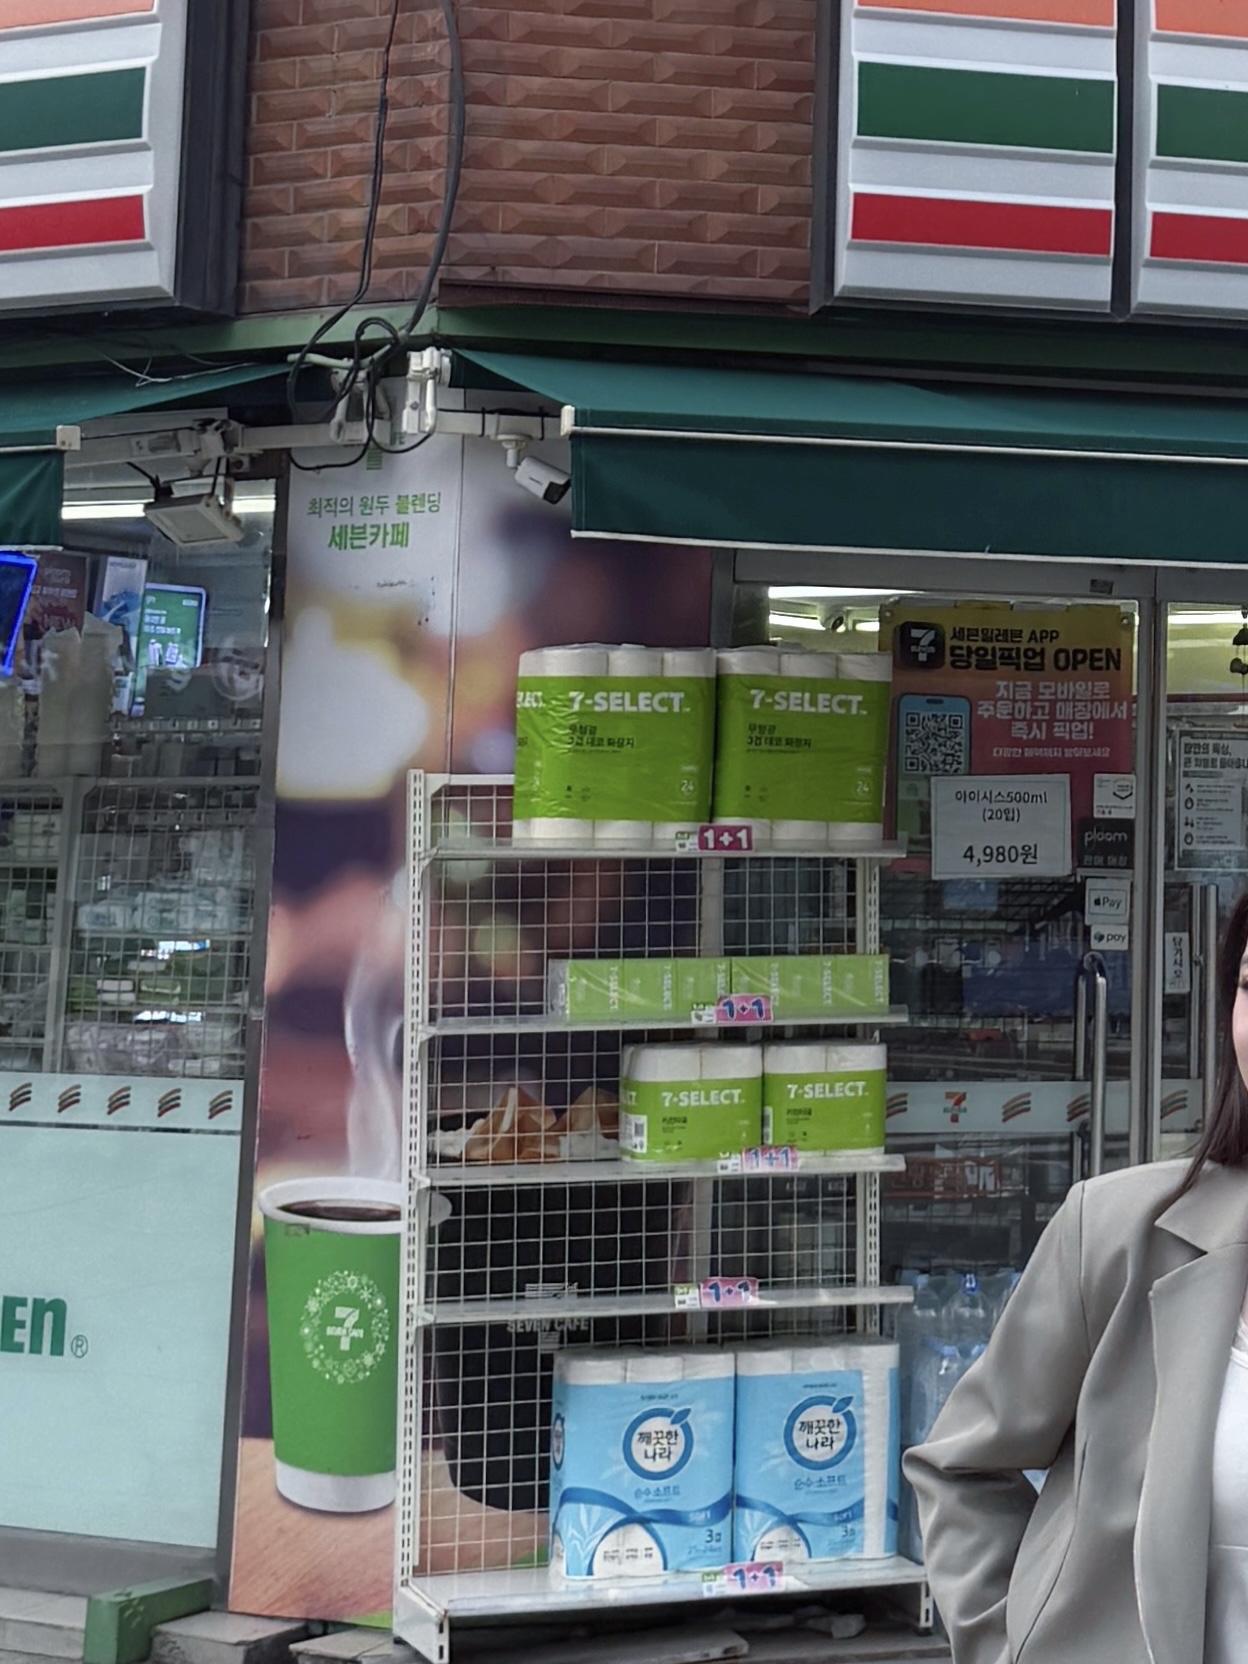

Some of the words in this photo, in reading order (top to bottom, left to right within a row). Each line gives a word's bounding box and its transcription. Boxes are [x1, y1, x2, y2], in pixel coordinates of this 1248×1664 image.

[308, 496, 353, 518] 최적의
[359, 495, 389, 515] 원두
[395, 492, 441, 514] 블렌딩
[328, 522, 410, 550] 세븐카페
[951, 626, 1023, 644] 세븐일레븐
[1027, 629, 1059, 643] APP
[950, 648, 1048, 671] 당일픽업
[1054, 648, 1121, 672] OPEN
[996, 681, 1032, 700] 지금
[1038, 681, 1110, 700] 모바일로
[569, 691, 685, 713] 7-SELECT
[751, 690, 862, 714] 7-SELECT
[977, 701, 1049, 719] 주문하고
[1056, 701, 1127, 719] 매장에서
[1011, 722, 1047, 740] 즉시
[1053, 722, 1094, 740] 픽업!
[955, 790, 1048, 804] 아이시스500ml
[982, 808, 1021, 823] (20입)
[703, 829, 750, 850] 1+1
[1084, 828, 1127, 844] ploom
[963, 844, 1038, 866] 4,980원
[1101, 895, 1122, 910] Pay
[1106, 932, 1127, 945] pay
[722, 998, 765, 1020] 1+1
[662, 1089, 742, 1107] 7-SELECT
[787, 1081, 866, 1098] 7-SELECT
[749, 1147, 790, 1168] 1+1
[708, 1281, 753, 1303] 1+1
[507, 1319, 550, 1332] SEVEN
[799, 1418, 842, 1434] 깨끗한
[637, 1430, 679, 1446] 깨끗한
[805, 1435, 835, 1451] 나라
[644, 1446, 672, 1462] 나라
[733, 1566, 778, 1589] 1+1
